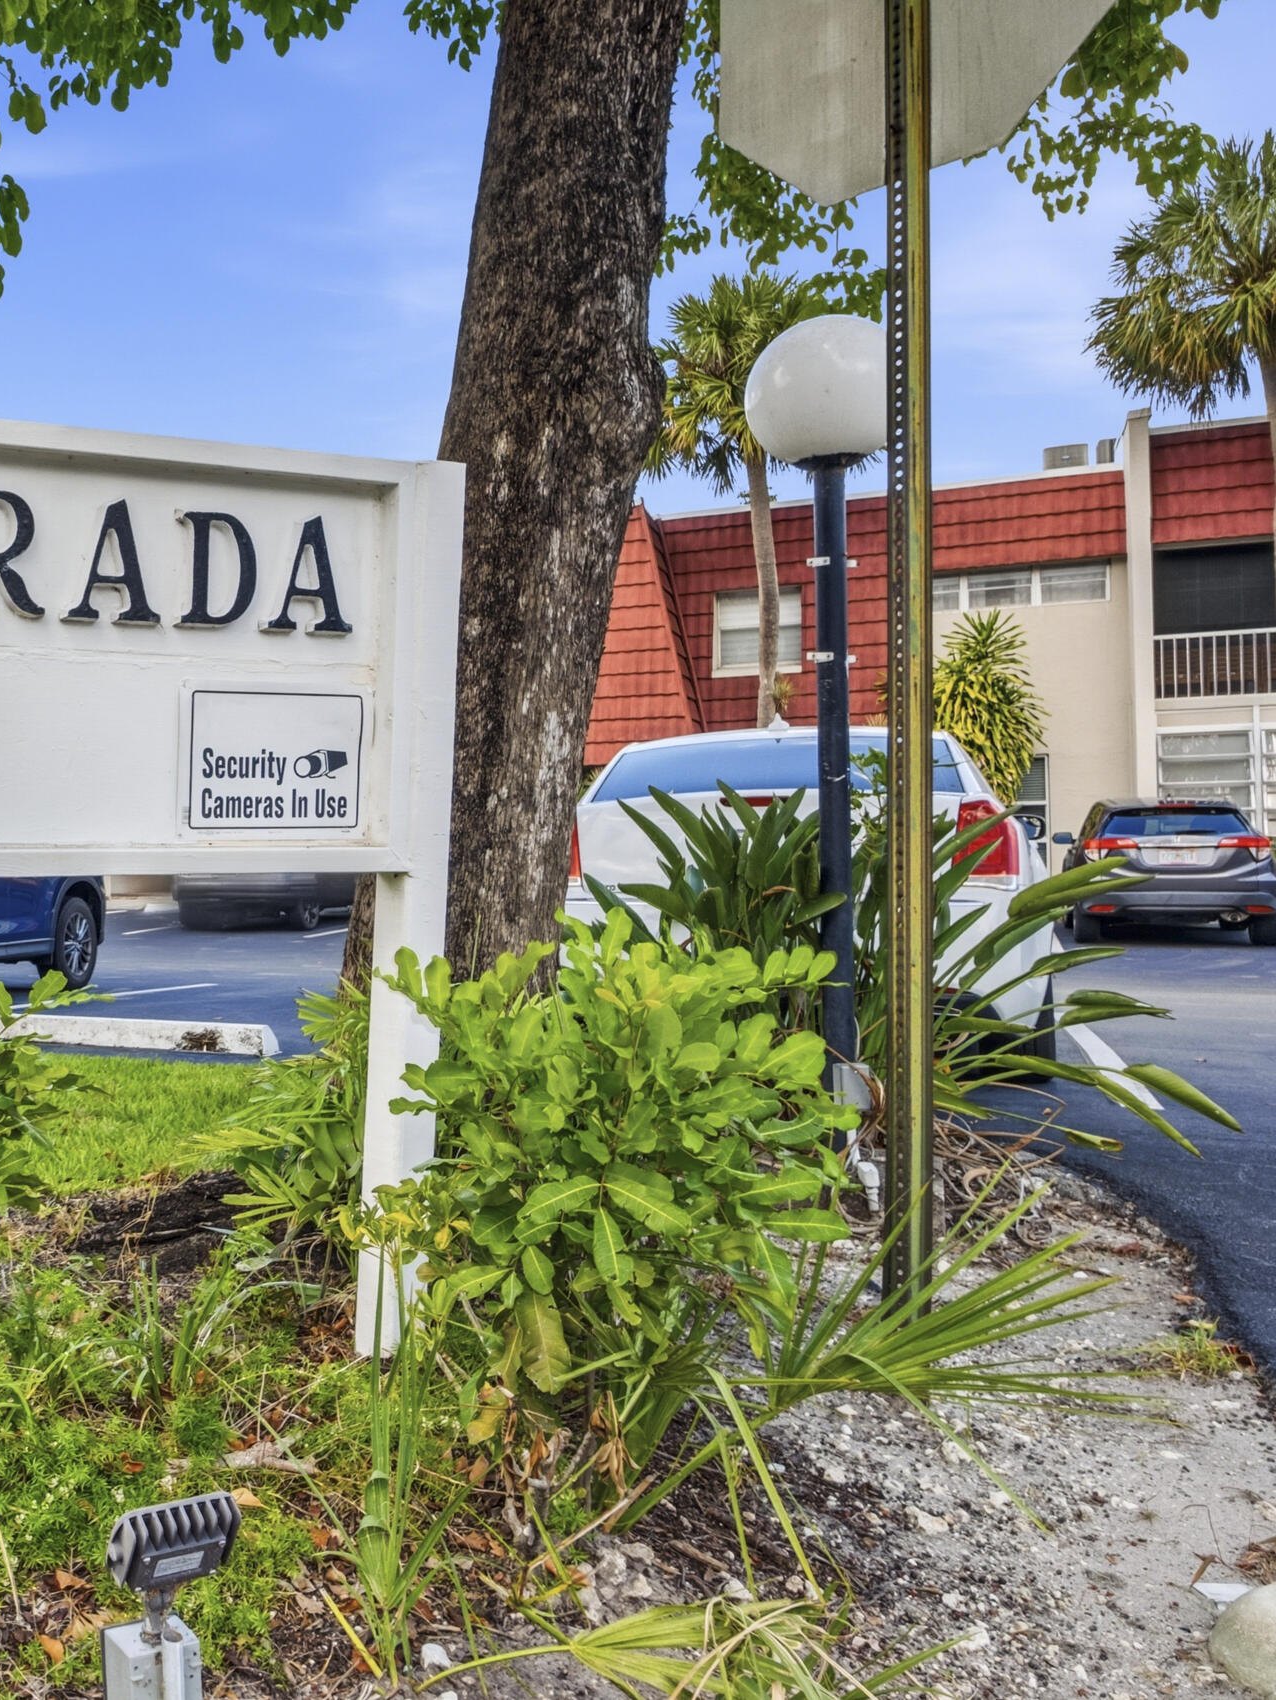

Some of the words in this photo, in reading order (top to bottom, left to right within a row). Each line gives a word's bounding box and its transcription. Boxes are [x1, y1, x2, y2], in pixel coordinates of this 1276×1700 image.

[201, 746, 287, 786] Security
[201, 787, 284, 819] Cameras
[291, 788, 308, 818] In
[315, 788, 348, 819] Use
